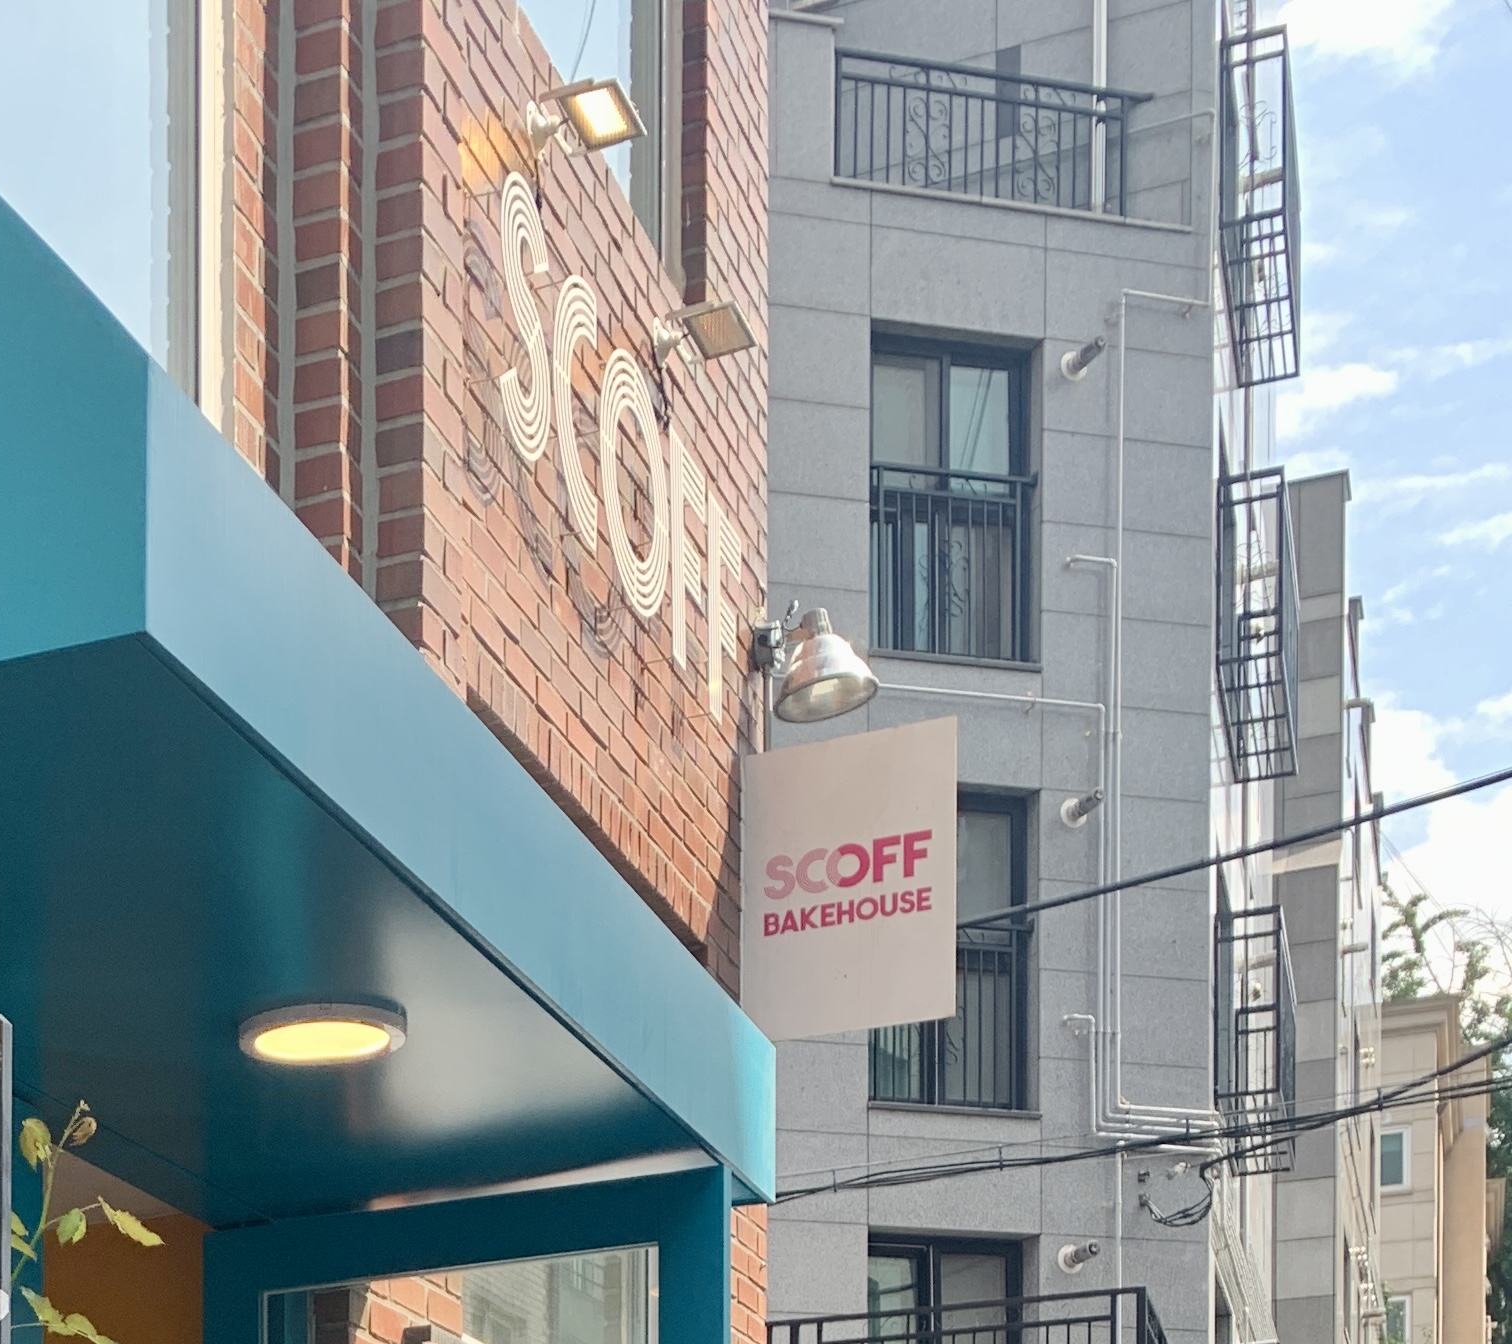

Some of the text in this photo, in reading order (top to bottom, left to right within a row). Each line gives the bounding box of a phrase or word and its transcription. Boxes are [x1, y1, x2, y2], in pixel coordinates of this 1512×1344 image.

[499, 171, 743, 726] SCOFF
[763, 829, 933, 900] SCOFF
[763, 886, 932, 937] BAKEHOUSE
